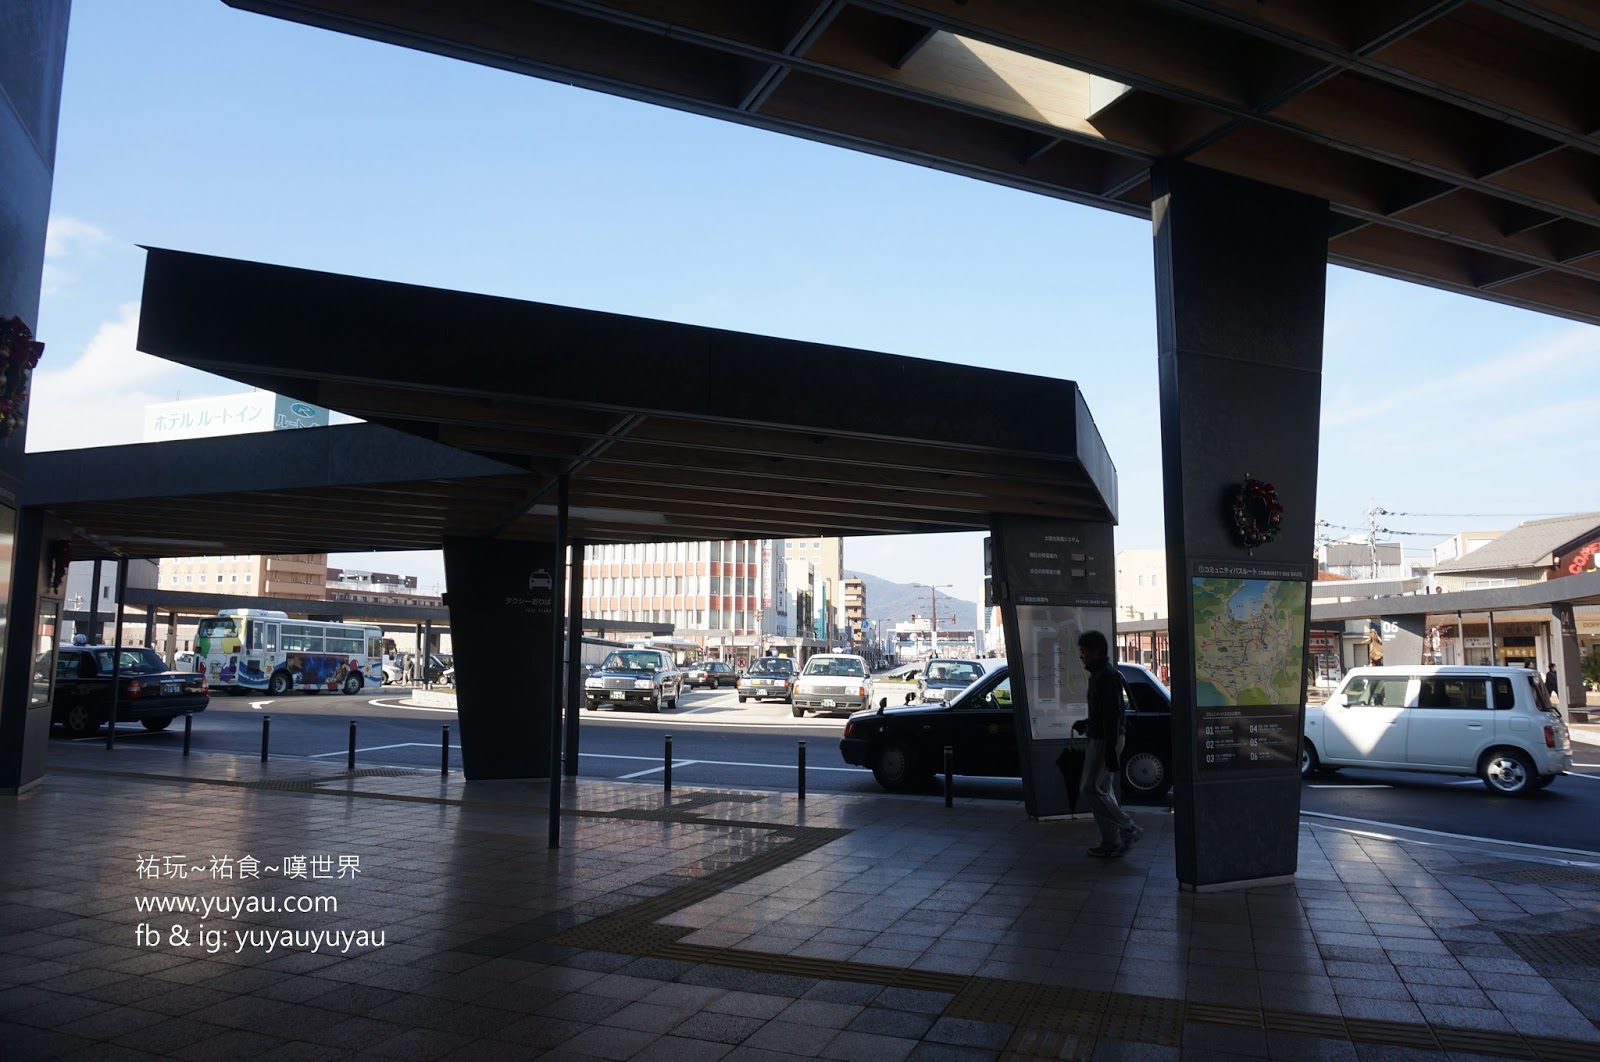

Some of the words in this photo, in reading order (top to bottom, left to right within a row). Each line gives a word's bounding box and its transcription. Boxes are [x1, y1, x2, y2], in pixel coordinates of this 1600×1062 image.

[153, 412, 194, 431] ホテル
[197, 405, 263, 428] ルートイン
[1204, 566, 1257, 575] コミュニティバスルート
[1382, 621, 1400, 633] 05
[1205, 726, 1214, 735] 01
[1205, 740, 1215, 749] 02
[1206, 754, 1215, 763] 03
